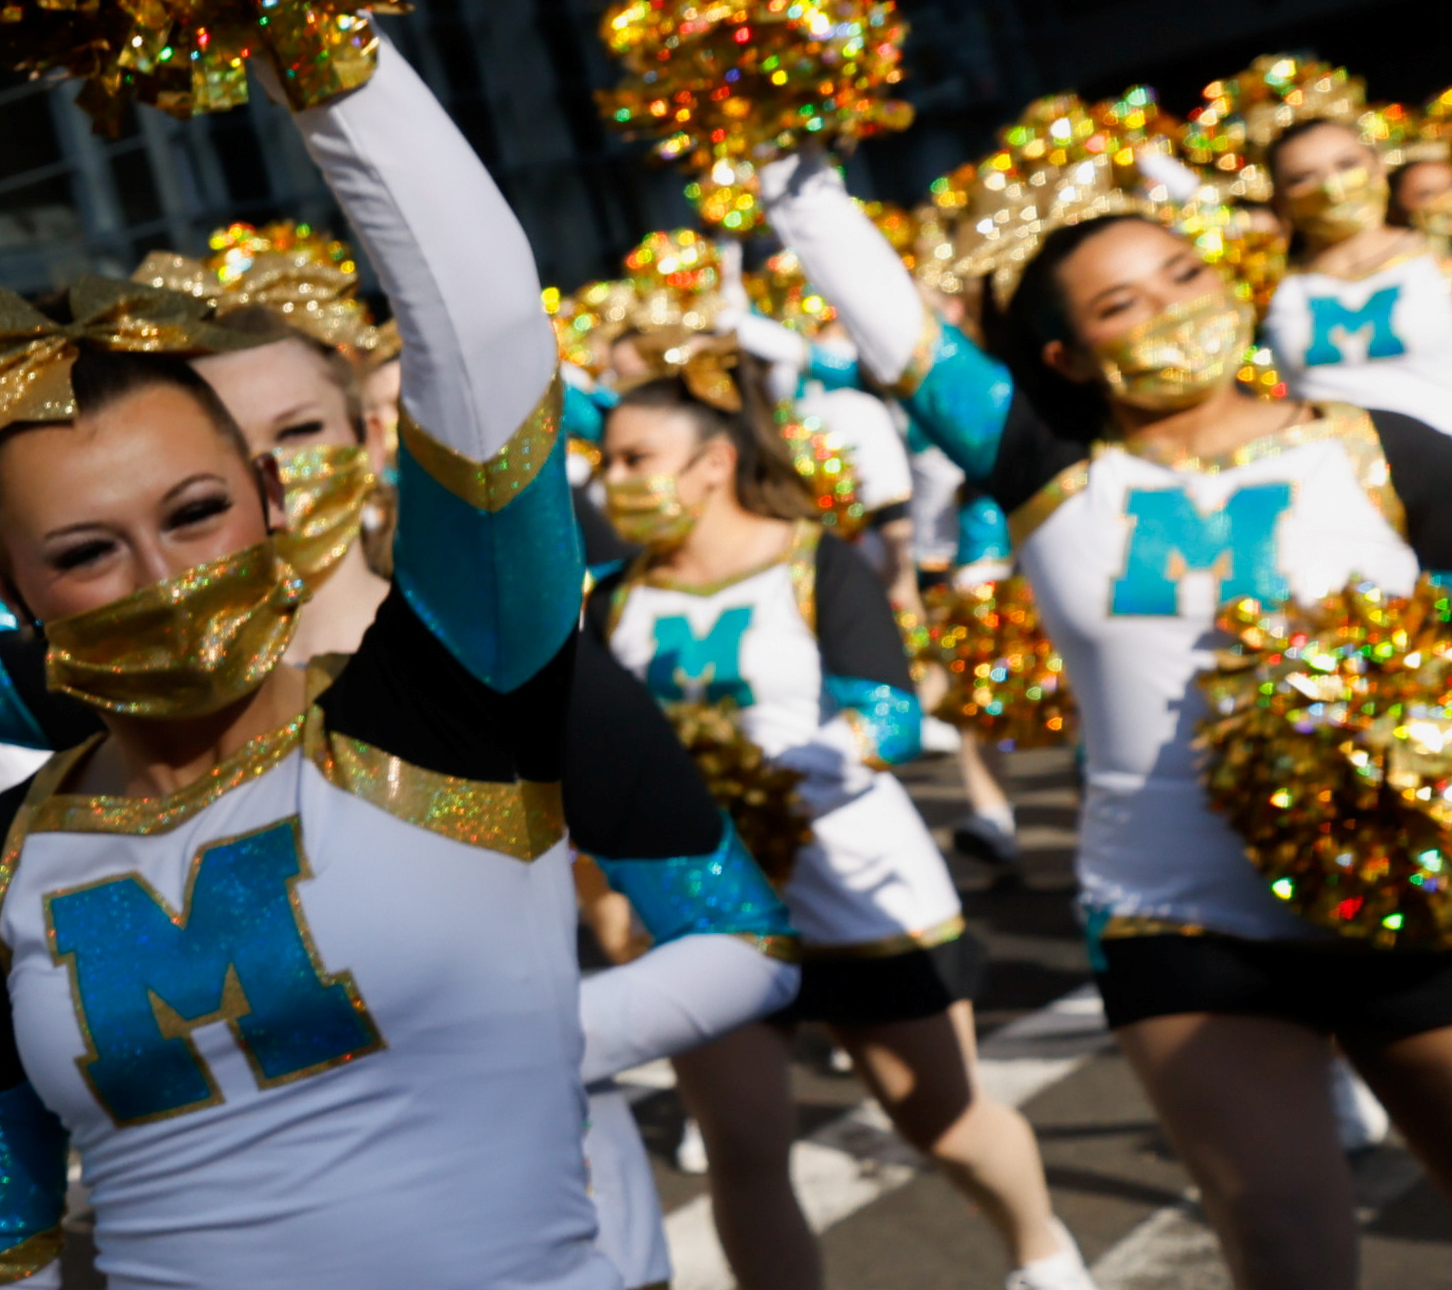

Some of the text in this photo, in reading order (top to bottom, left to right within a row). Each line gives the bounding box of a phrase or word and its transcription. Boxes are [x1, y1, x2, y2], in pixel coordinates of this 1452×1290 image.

[1304, 282, 1407, 367] M
[1108, 480, 1301, 618] M
[646, 602, 756, 707] M
[42, 814, 389, 1129] M
